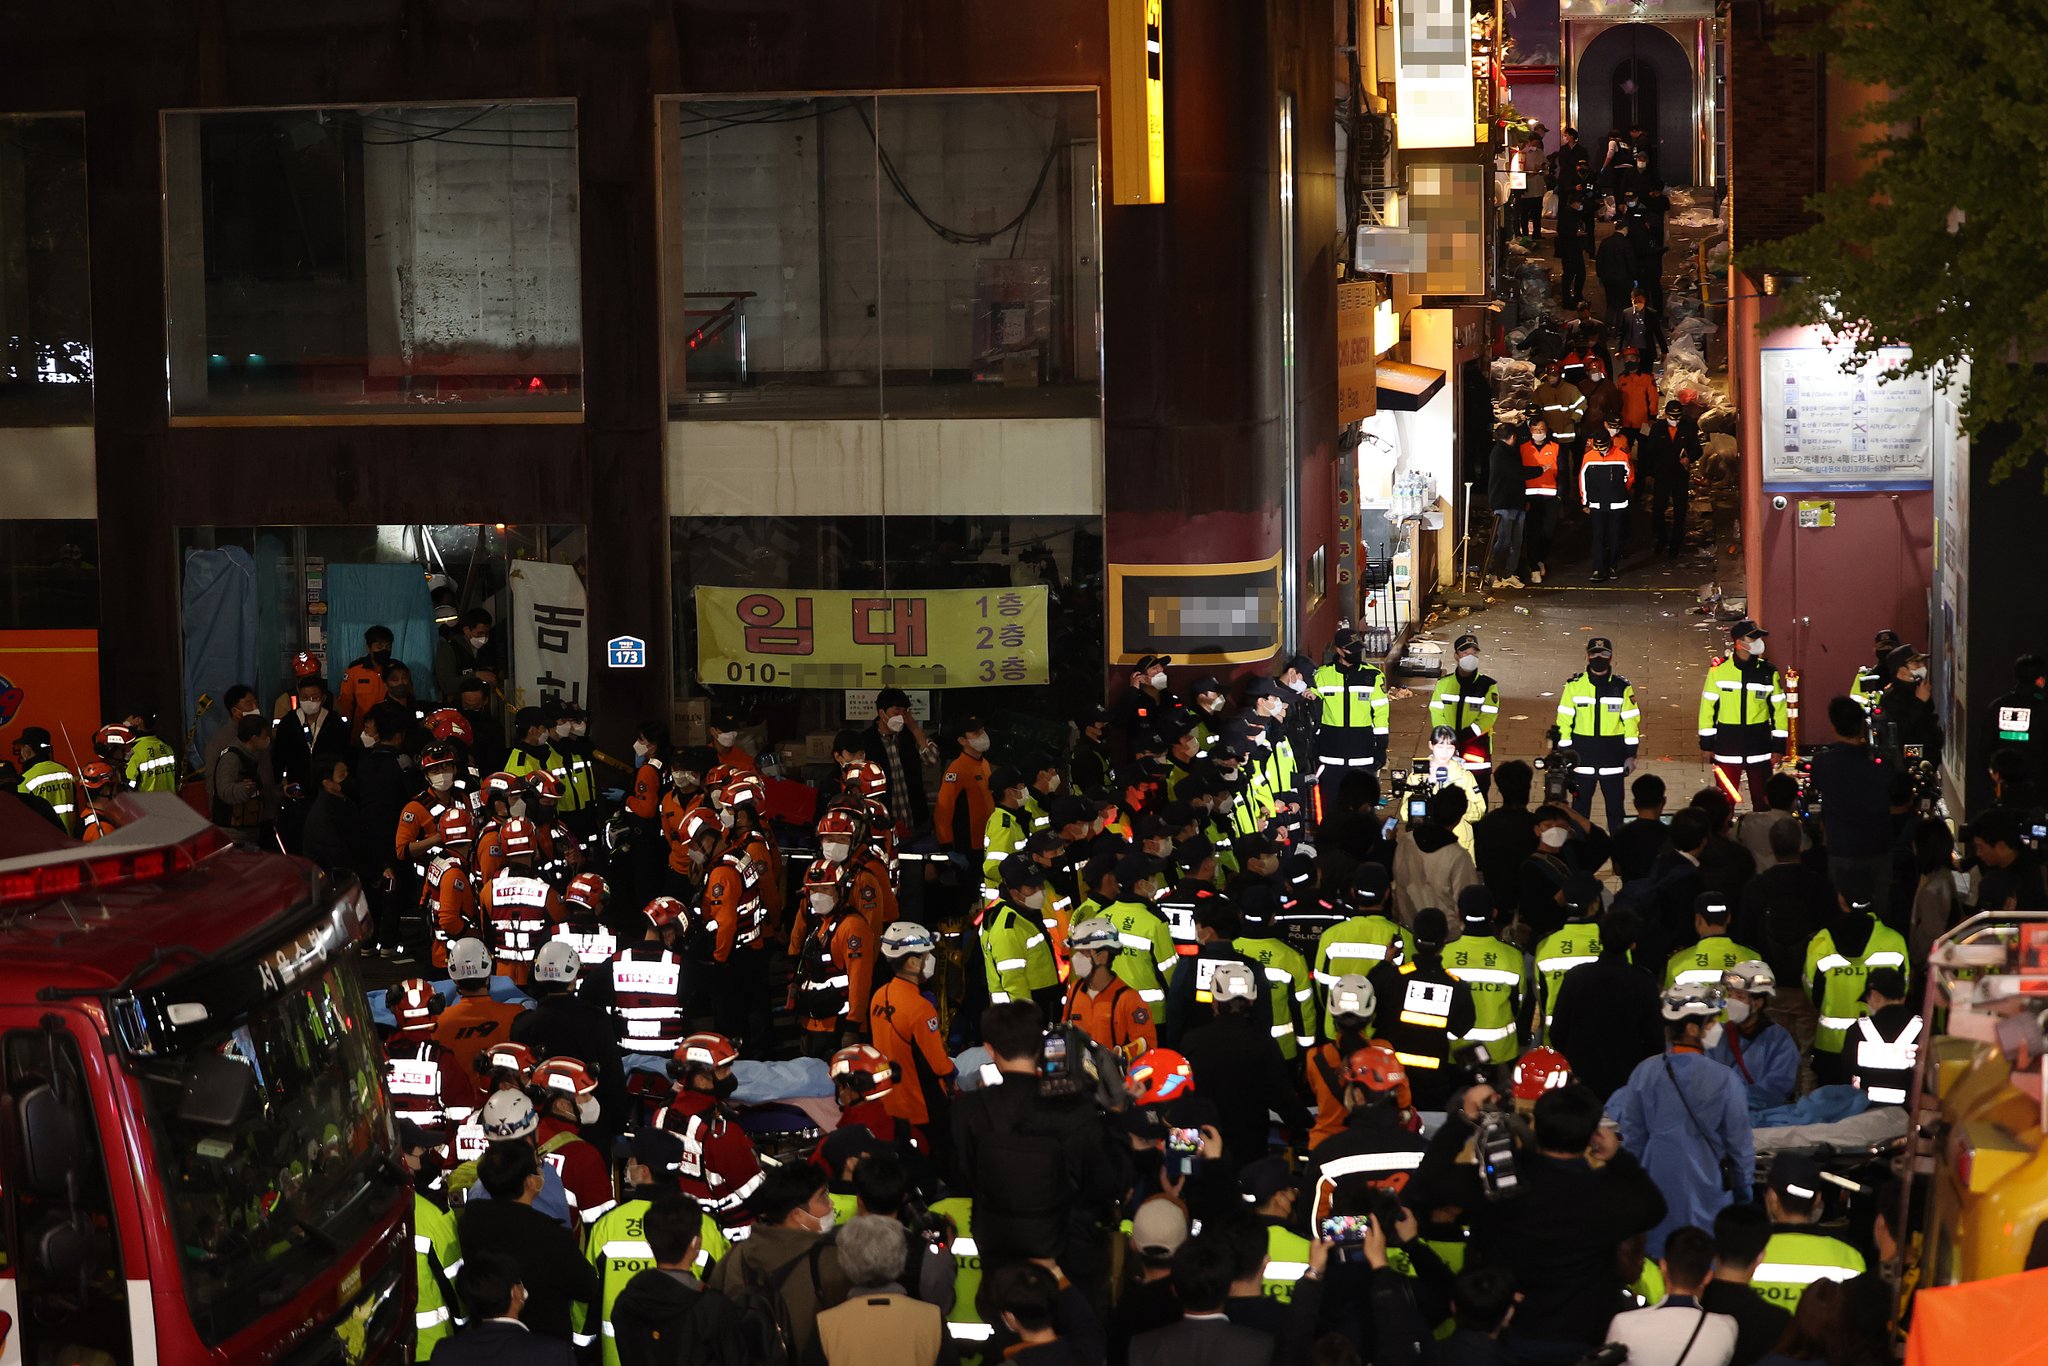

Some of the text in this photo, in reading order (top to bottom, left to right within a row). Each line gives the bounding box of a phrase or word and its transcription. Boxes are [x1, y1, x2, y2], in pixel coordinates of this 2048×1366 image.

[975, 592, 1024, 618] 1층
[975, 623, 1026, 650] 2층
[615, 651, 638, 664] 173
[978, 656, 1028, 683] 3층
[1455, 950, 1498, 968] 경찰
[454, 1020, 499, 1041] 119
